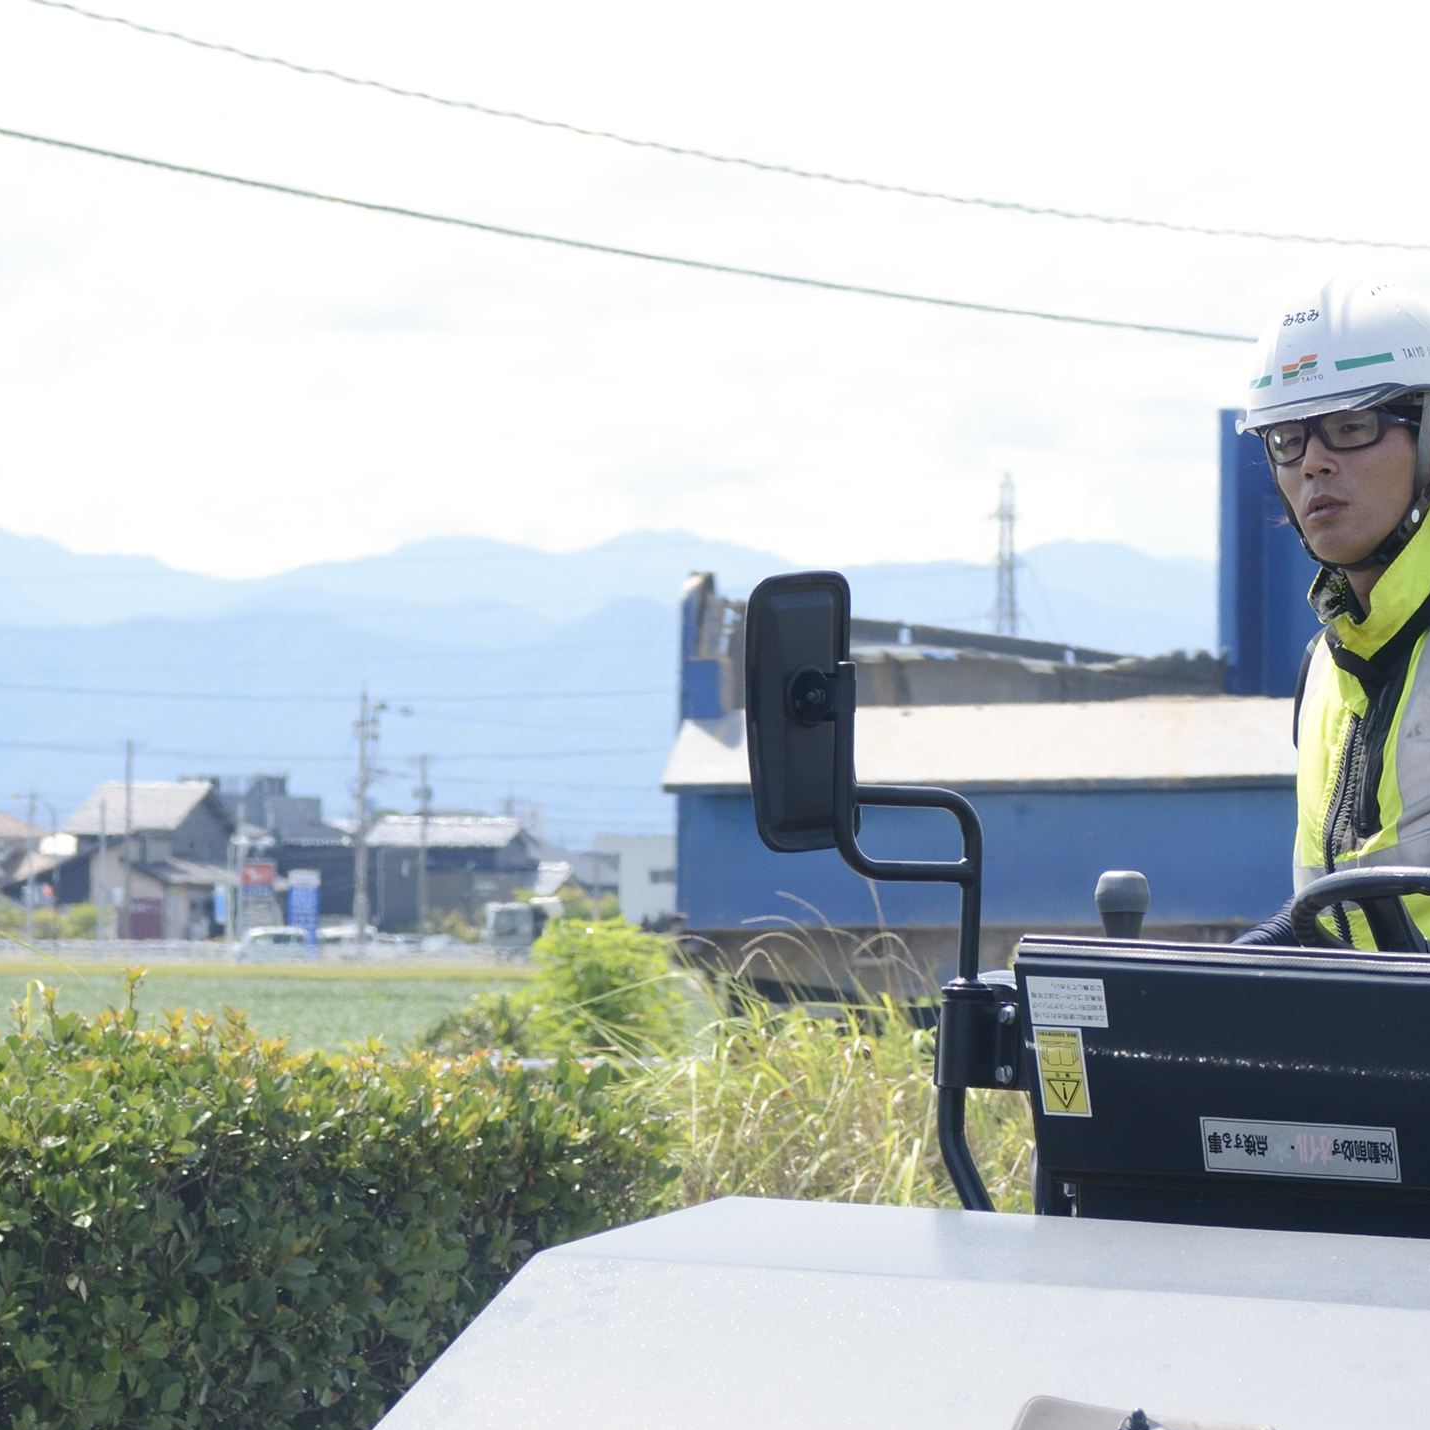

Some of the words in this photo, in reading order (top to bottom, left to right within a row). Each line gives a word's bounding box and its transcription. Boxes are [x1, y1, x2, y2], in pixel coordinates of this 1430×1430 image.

[1283, 309, 1320, 327] みなみ
[1401, 345, 1425, 360] TAIYO
[1301, 373, 1324, 383] TAIYO
